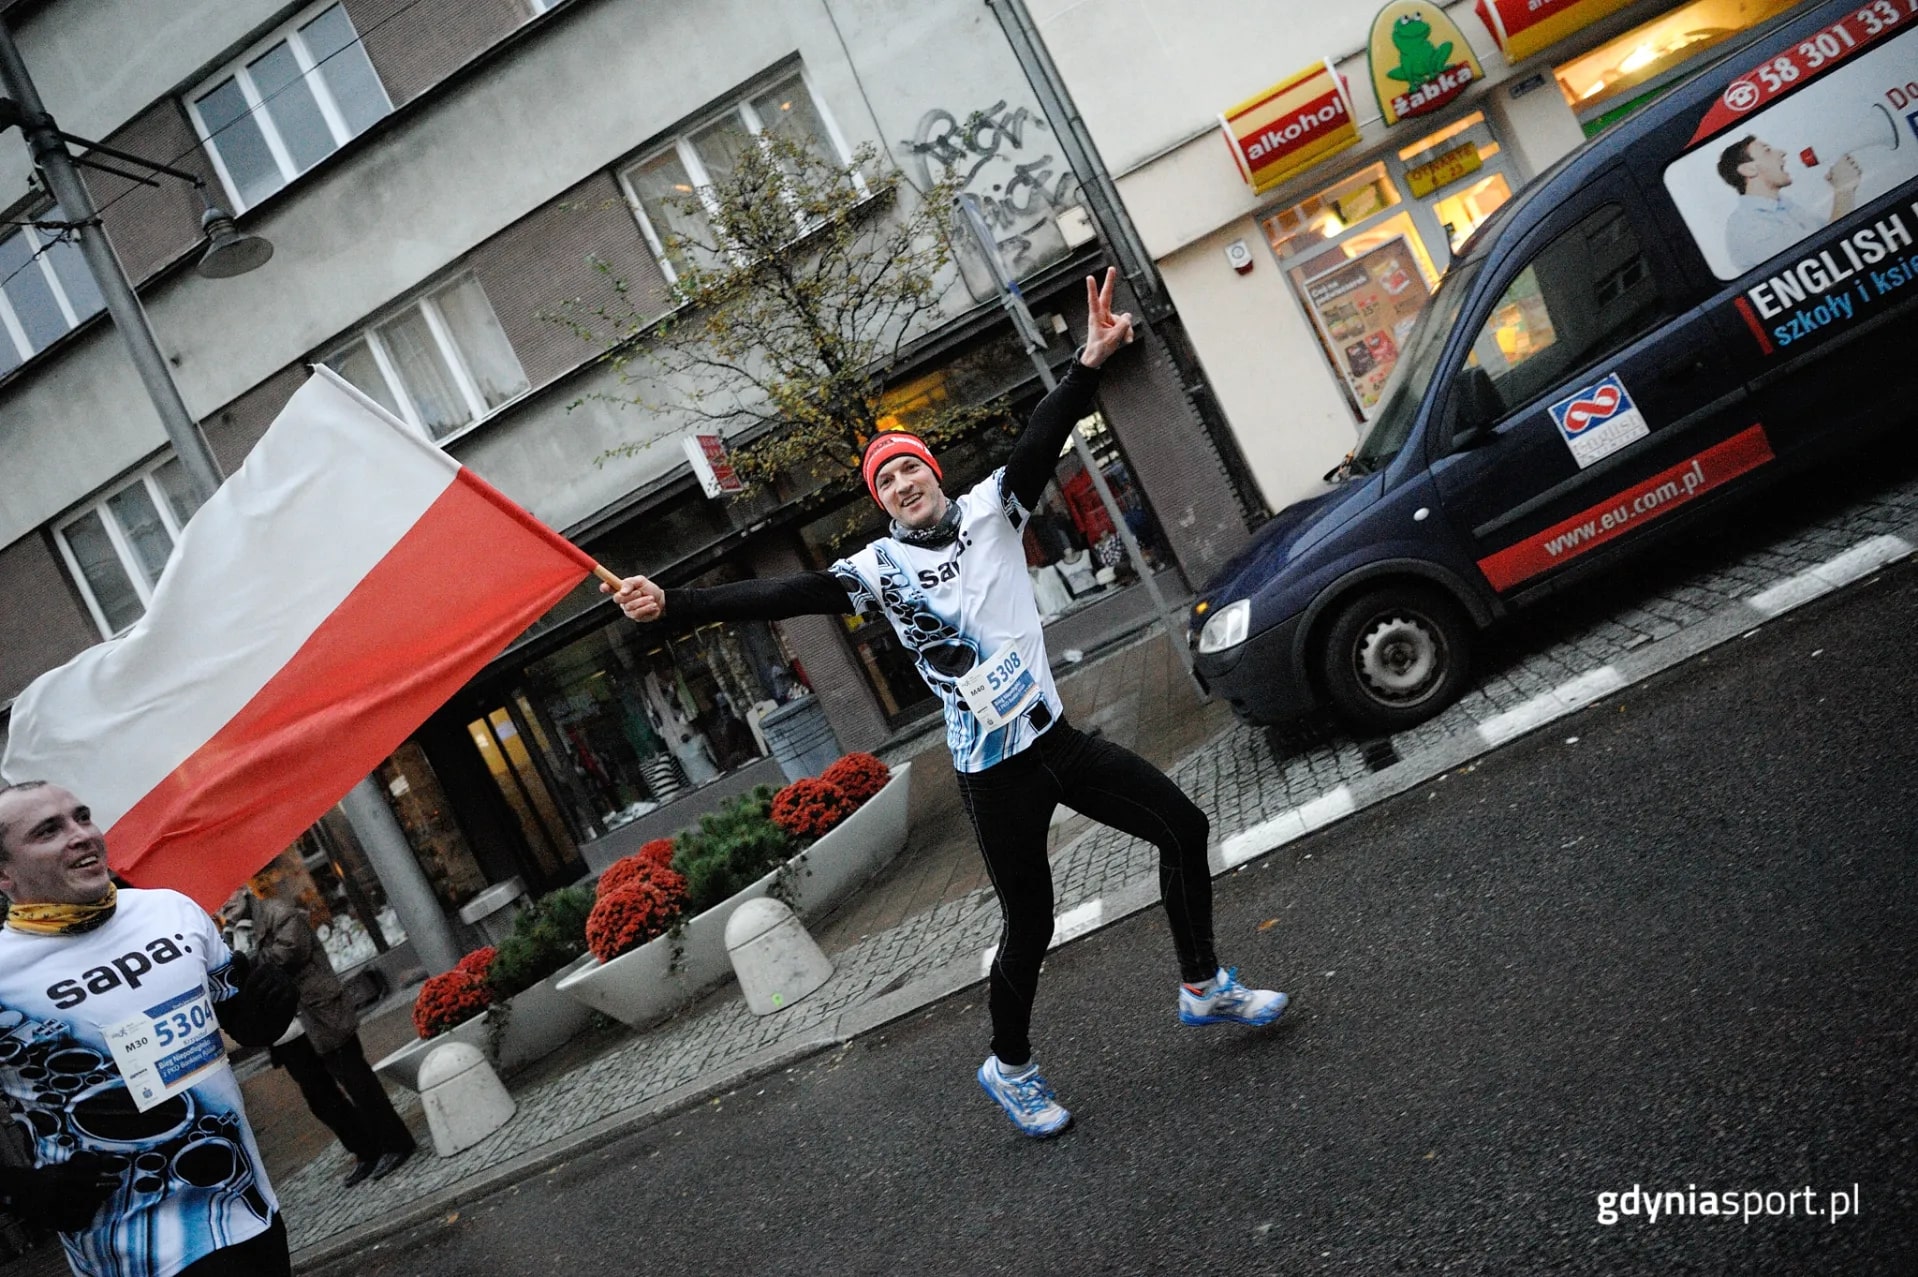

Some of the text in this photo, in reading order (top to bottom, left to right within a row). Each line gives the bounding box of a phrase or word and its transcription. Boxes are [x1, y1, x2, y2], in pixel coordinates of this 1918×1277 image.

[1758, 0, 1899, 93] 58 301 33
[1394, 65, 1473, 117] żabka
[1247, 96, 1345, 161] alkohol
[1748, 213, 1913, 320] ENGLISH
[1773, 290, 1855, 347] szkoły
[1854, 278, 1871, 303] i
[1544, 459, 1706, 557] www.eu.com.pl
[986, 651, 1021, 691] 5308
[46, 933, 193, 1010] sapa:
[124, 1036, 149, 1054] M30
[153, 999, 214, 1048] 5304
